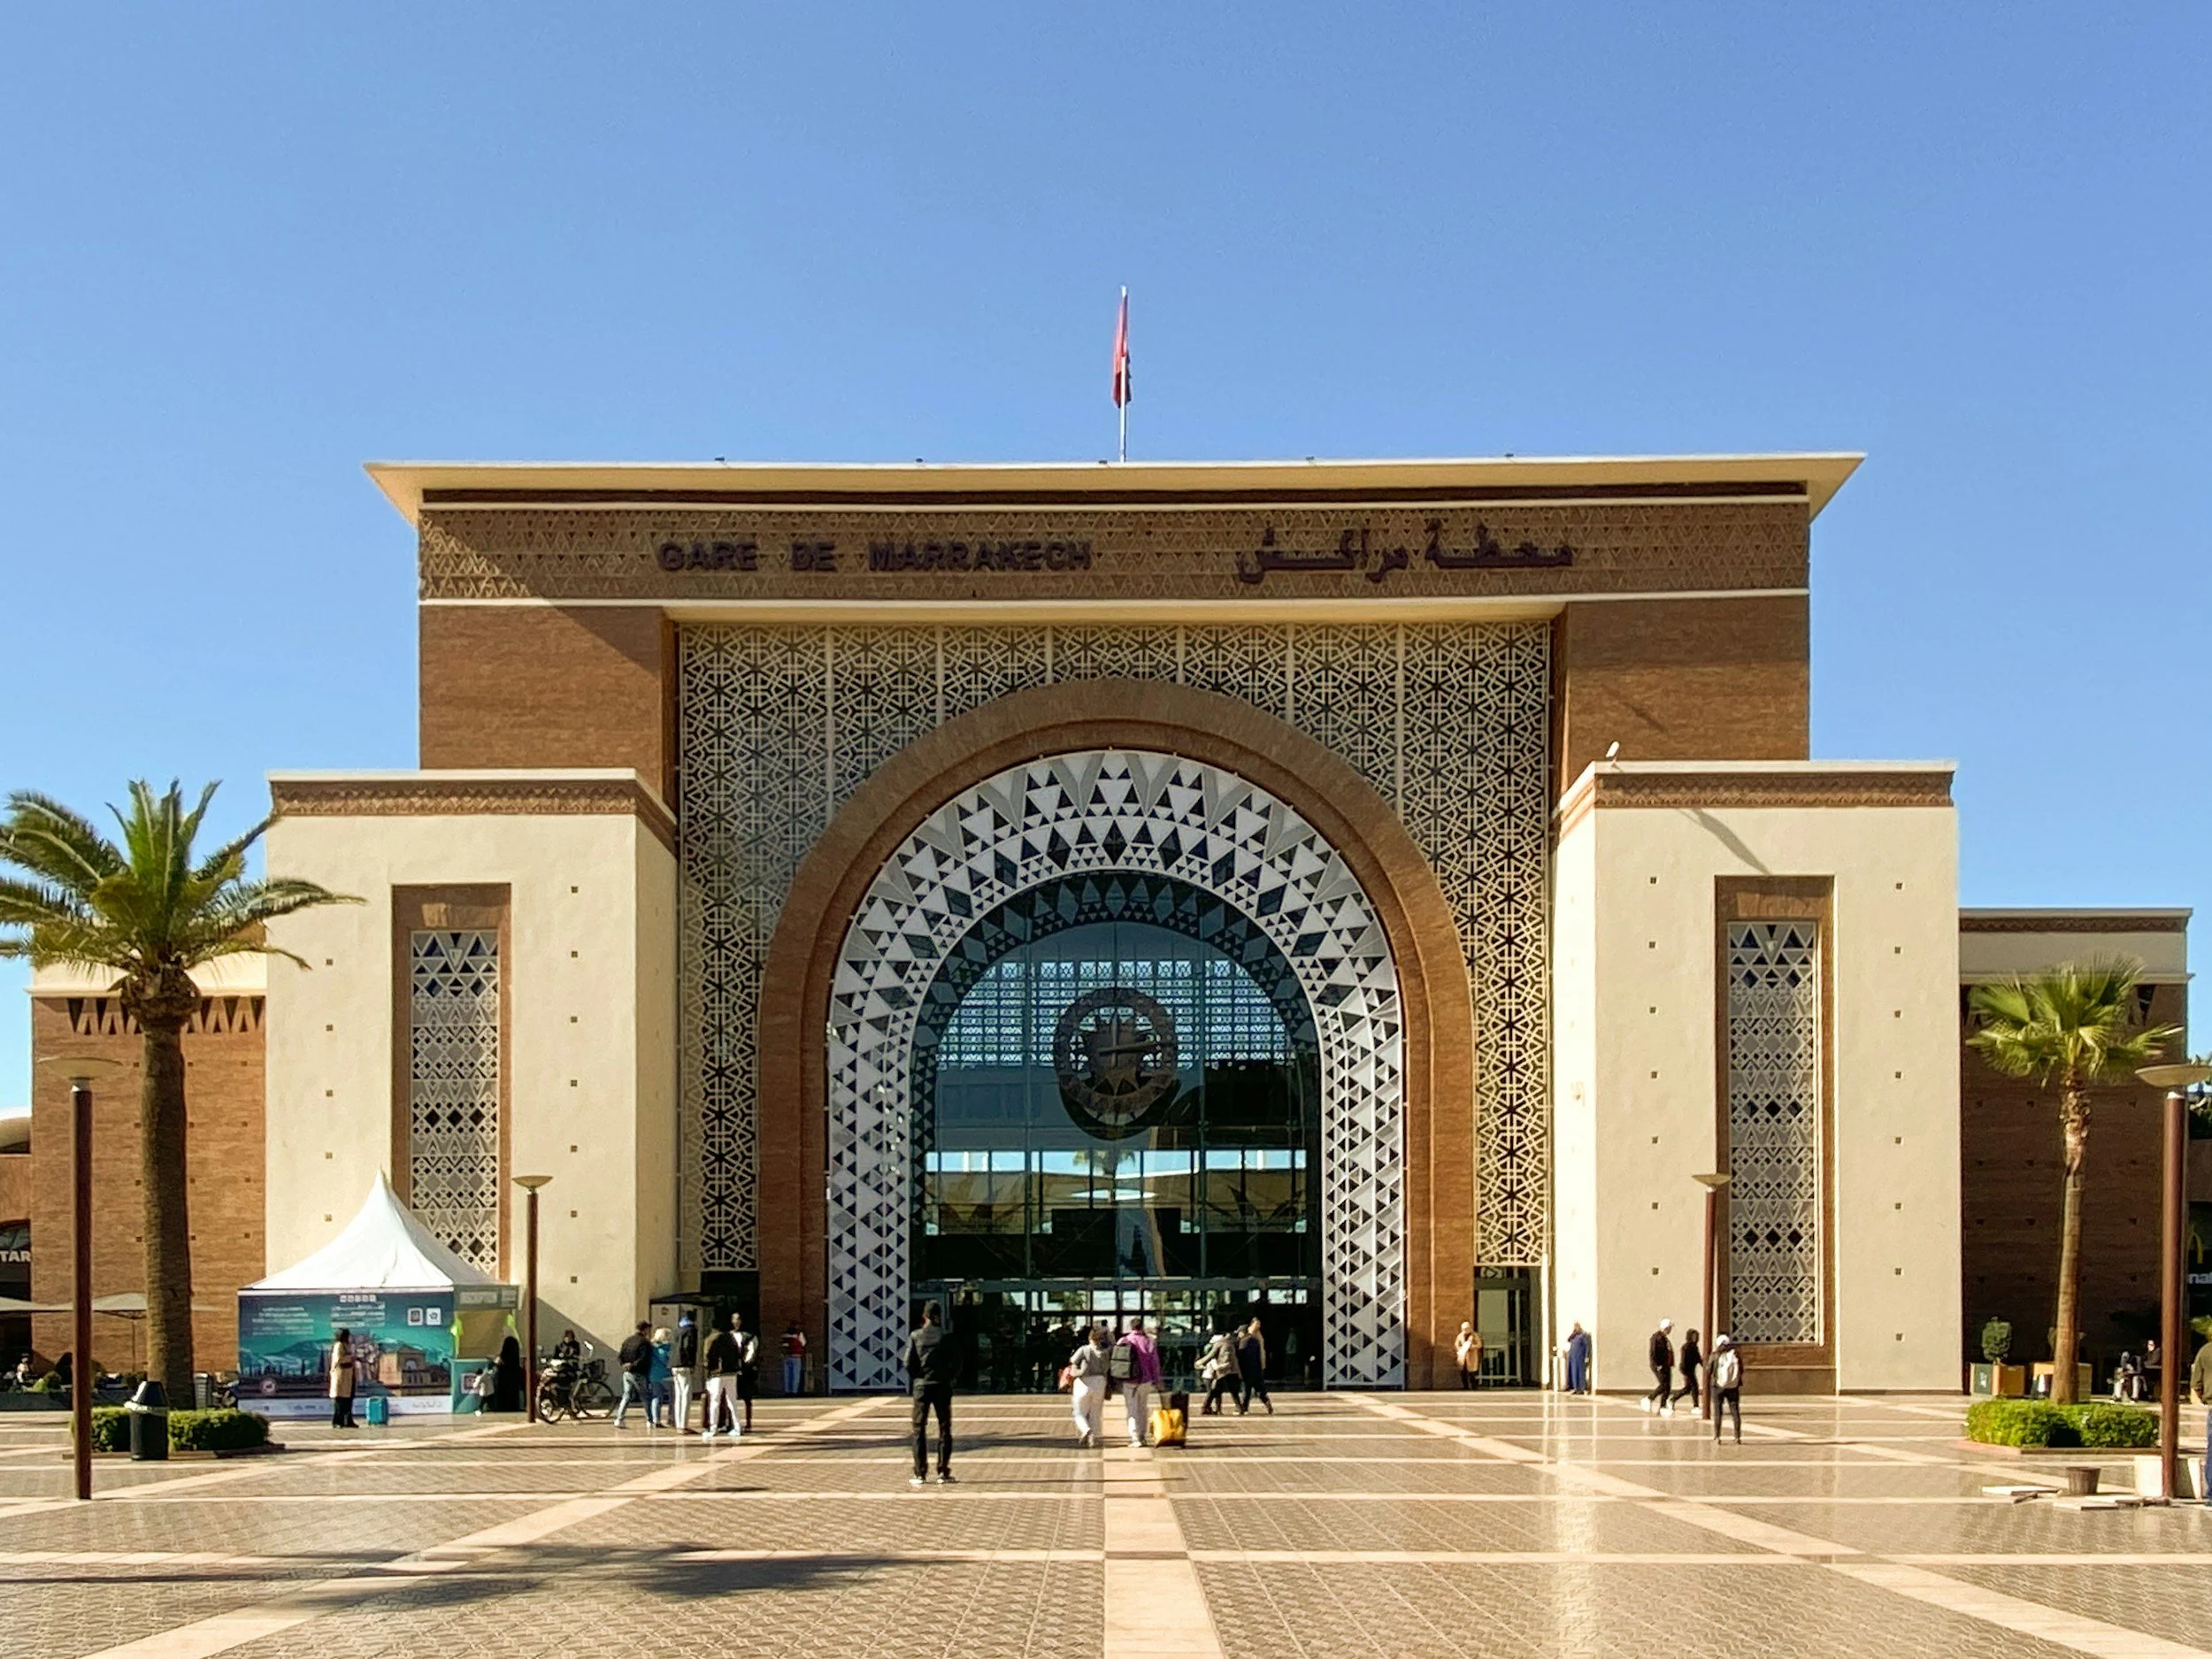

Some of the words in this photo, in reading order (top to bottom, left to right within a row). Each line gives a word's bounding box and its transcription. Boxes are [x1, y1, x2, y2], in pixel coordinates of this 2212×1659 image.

[658, 542, 757, 572] GARE
[790, 542, 836, 572] DE
[868, 541, 1093, 571] MARRAKECH
